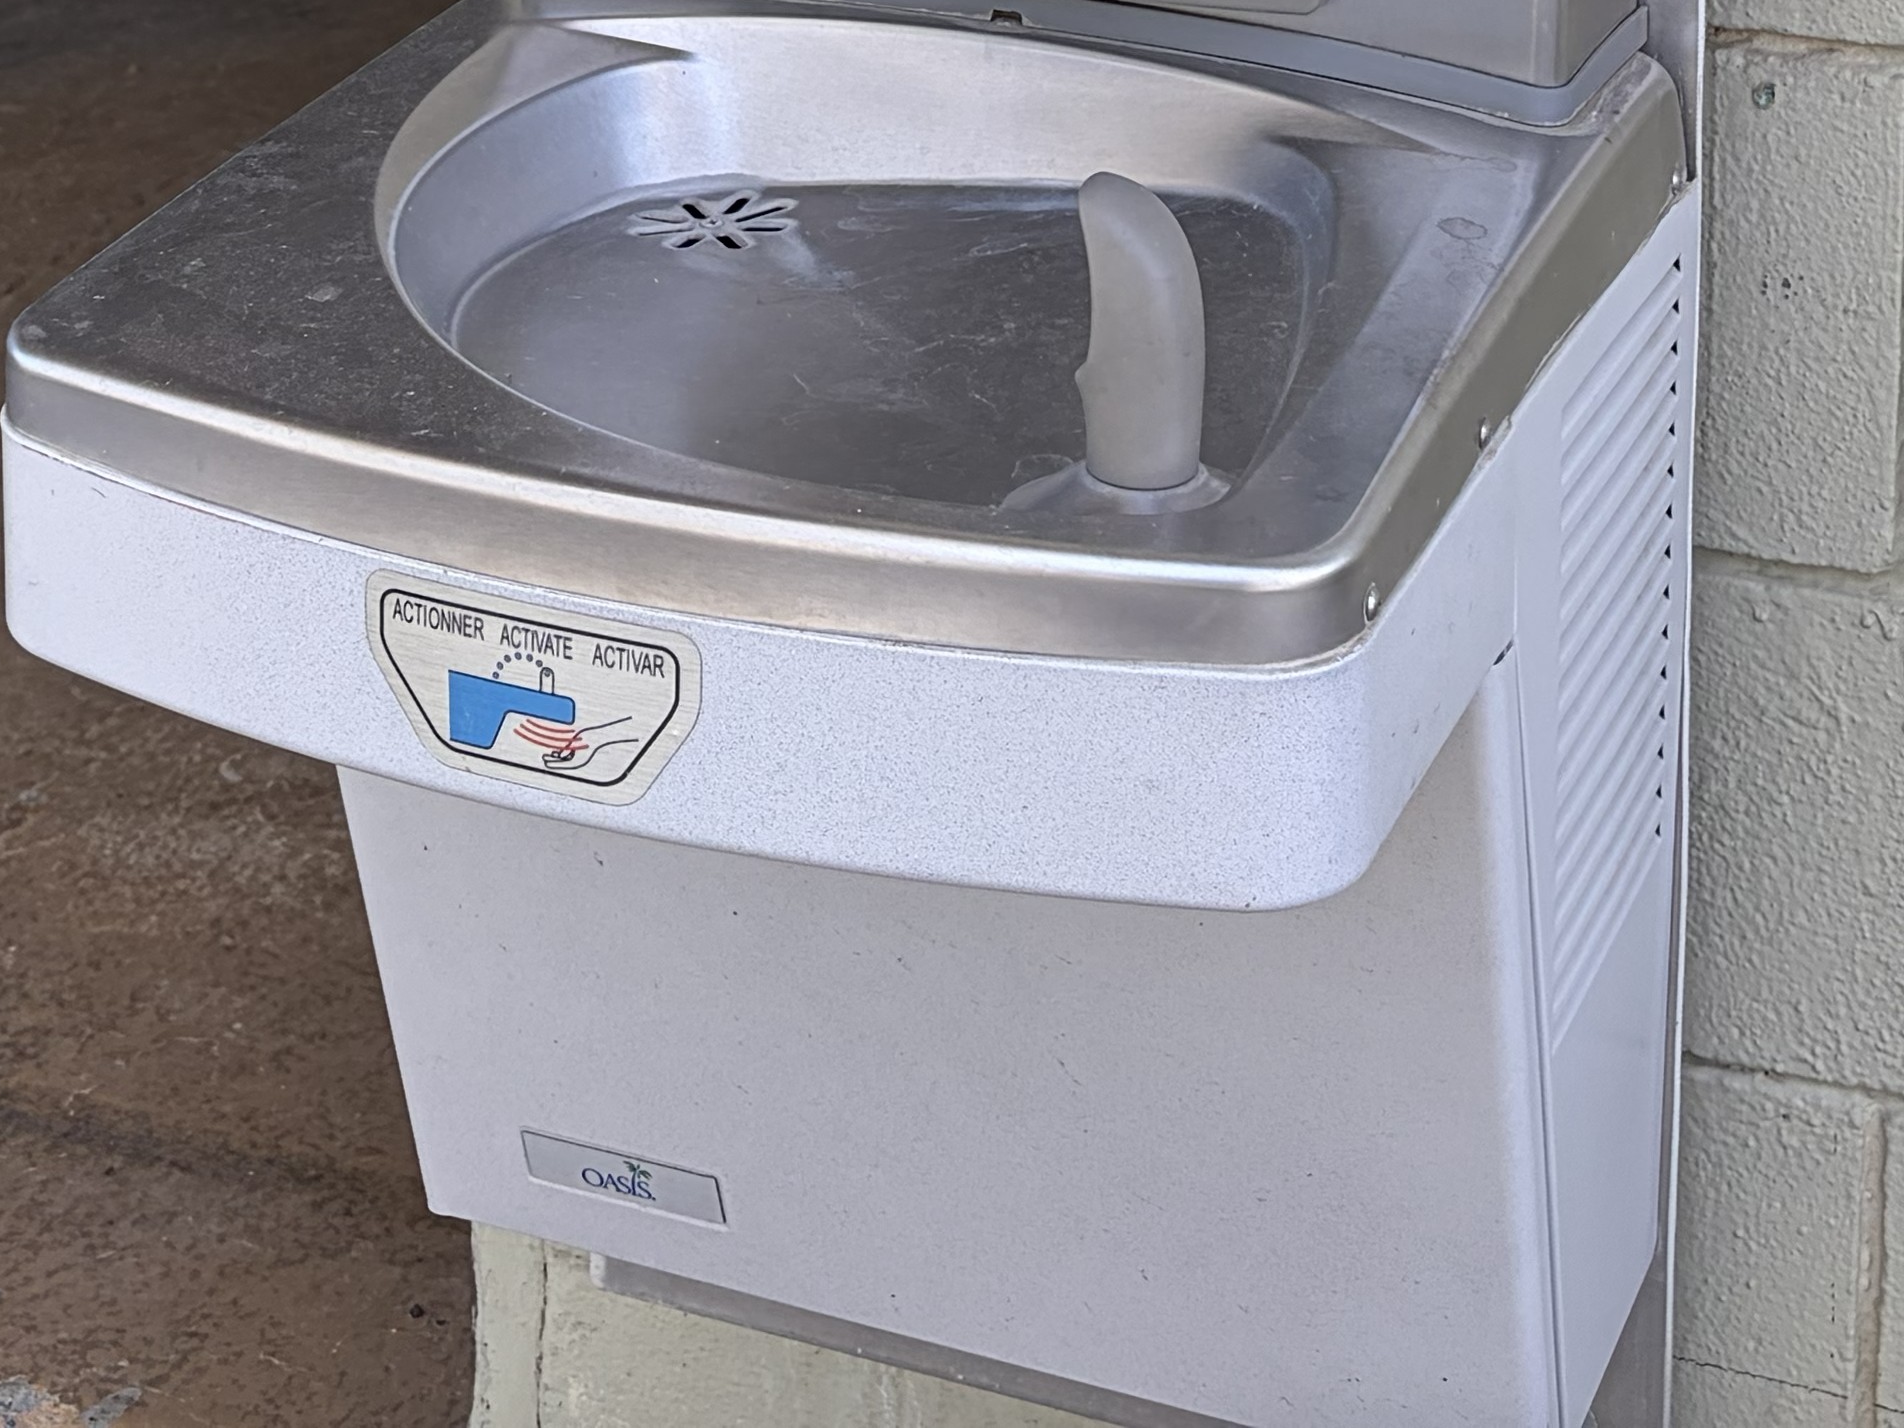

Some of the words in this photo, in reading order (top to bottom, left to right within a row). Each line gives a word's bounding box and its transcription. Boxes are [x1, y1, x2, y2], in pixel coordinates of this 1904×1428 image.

[393, 598, 485, 641] ACTIONNER
[500, 624, 573, 660] ACTIVATE
[592, 644, 665, 678] ACTIVAR
